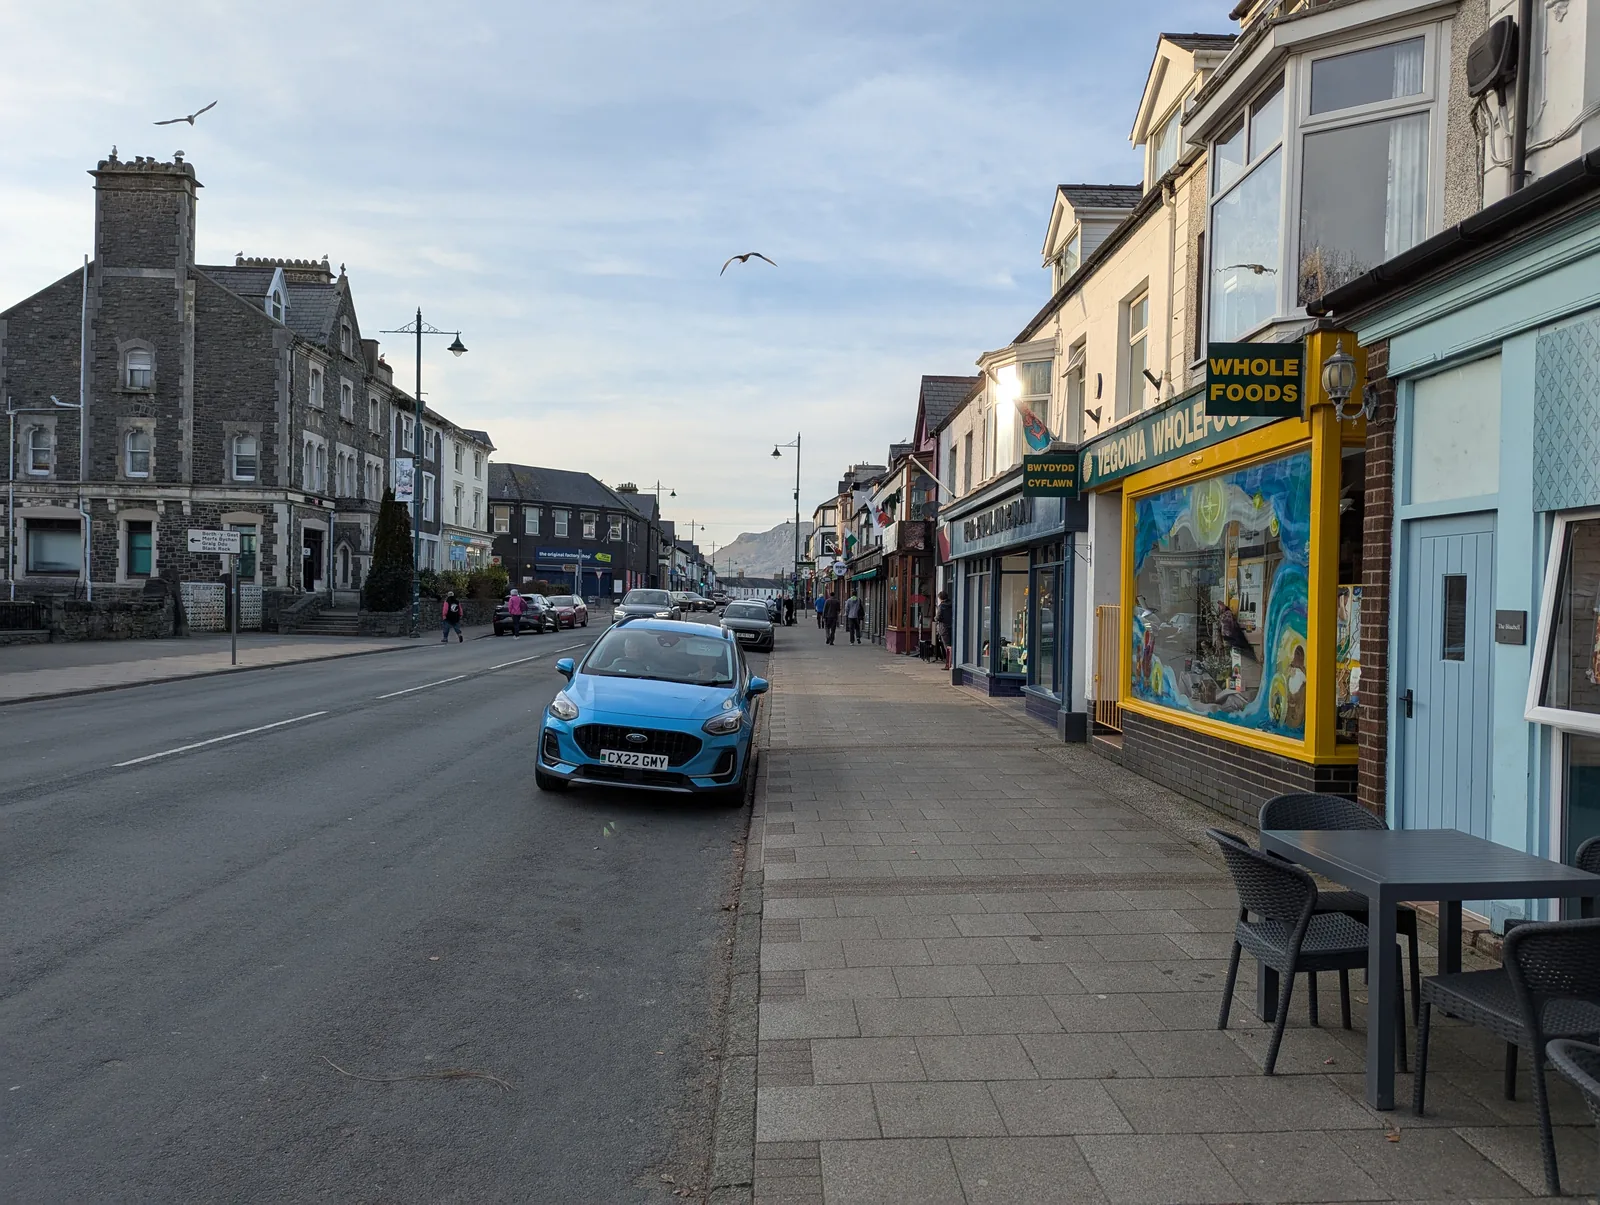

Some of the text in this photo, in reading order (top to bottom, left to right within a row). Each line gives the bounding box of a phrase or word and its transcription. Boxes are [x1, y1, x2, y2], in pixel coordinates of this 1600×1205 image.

[1209, 358, 1299, 376] WHOLE
[1210, 384, 1298, 402] FOODS
[1097, 429, 1147, 477] VEGONIA
[1027, 463, 1075, 472] BWYDYDD
[1028, 479, 1073, 487] CYFLAWN
[608, 751, 666, 768] CX22 GMY
